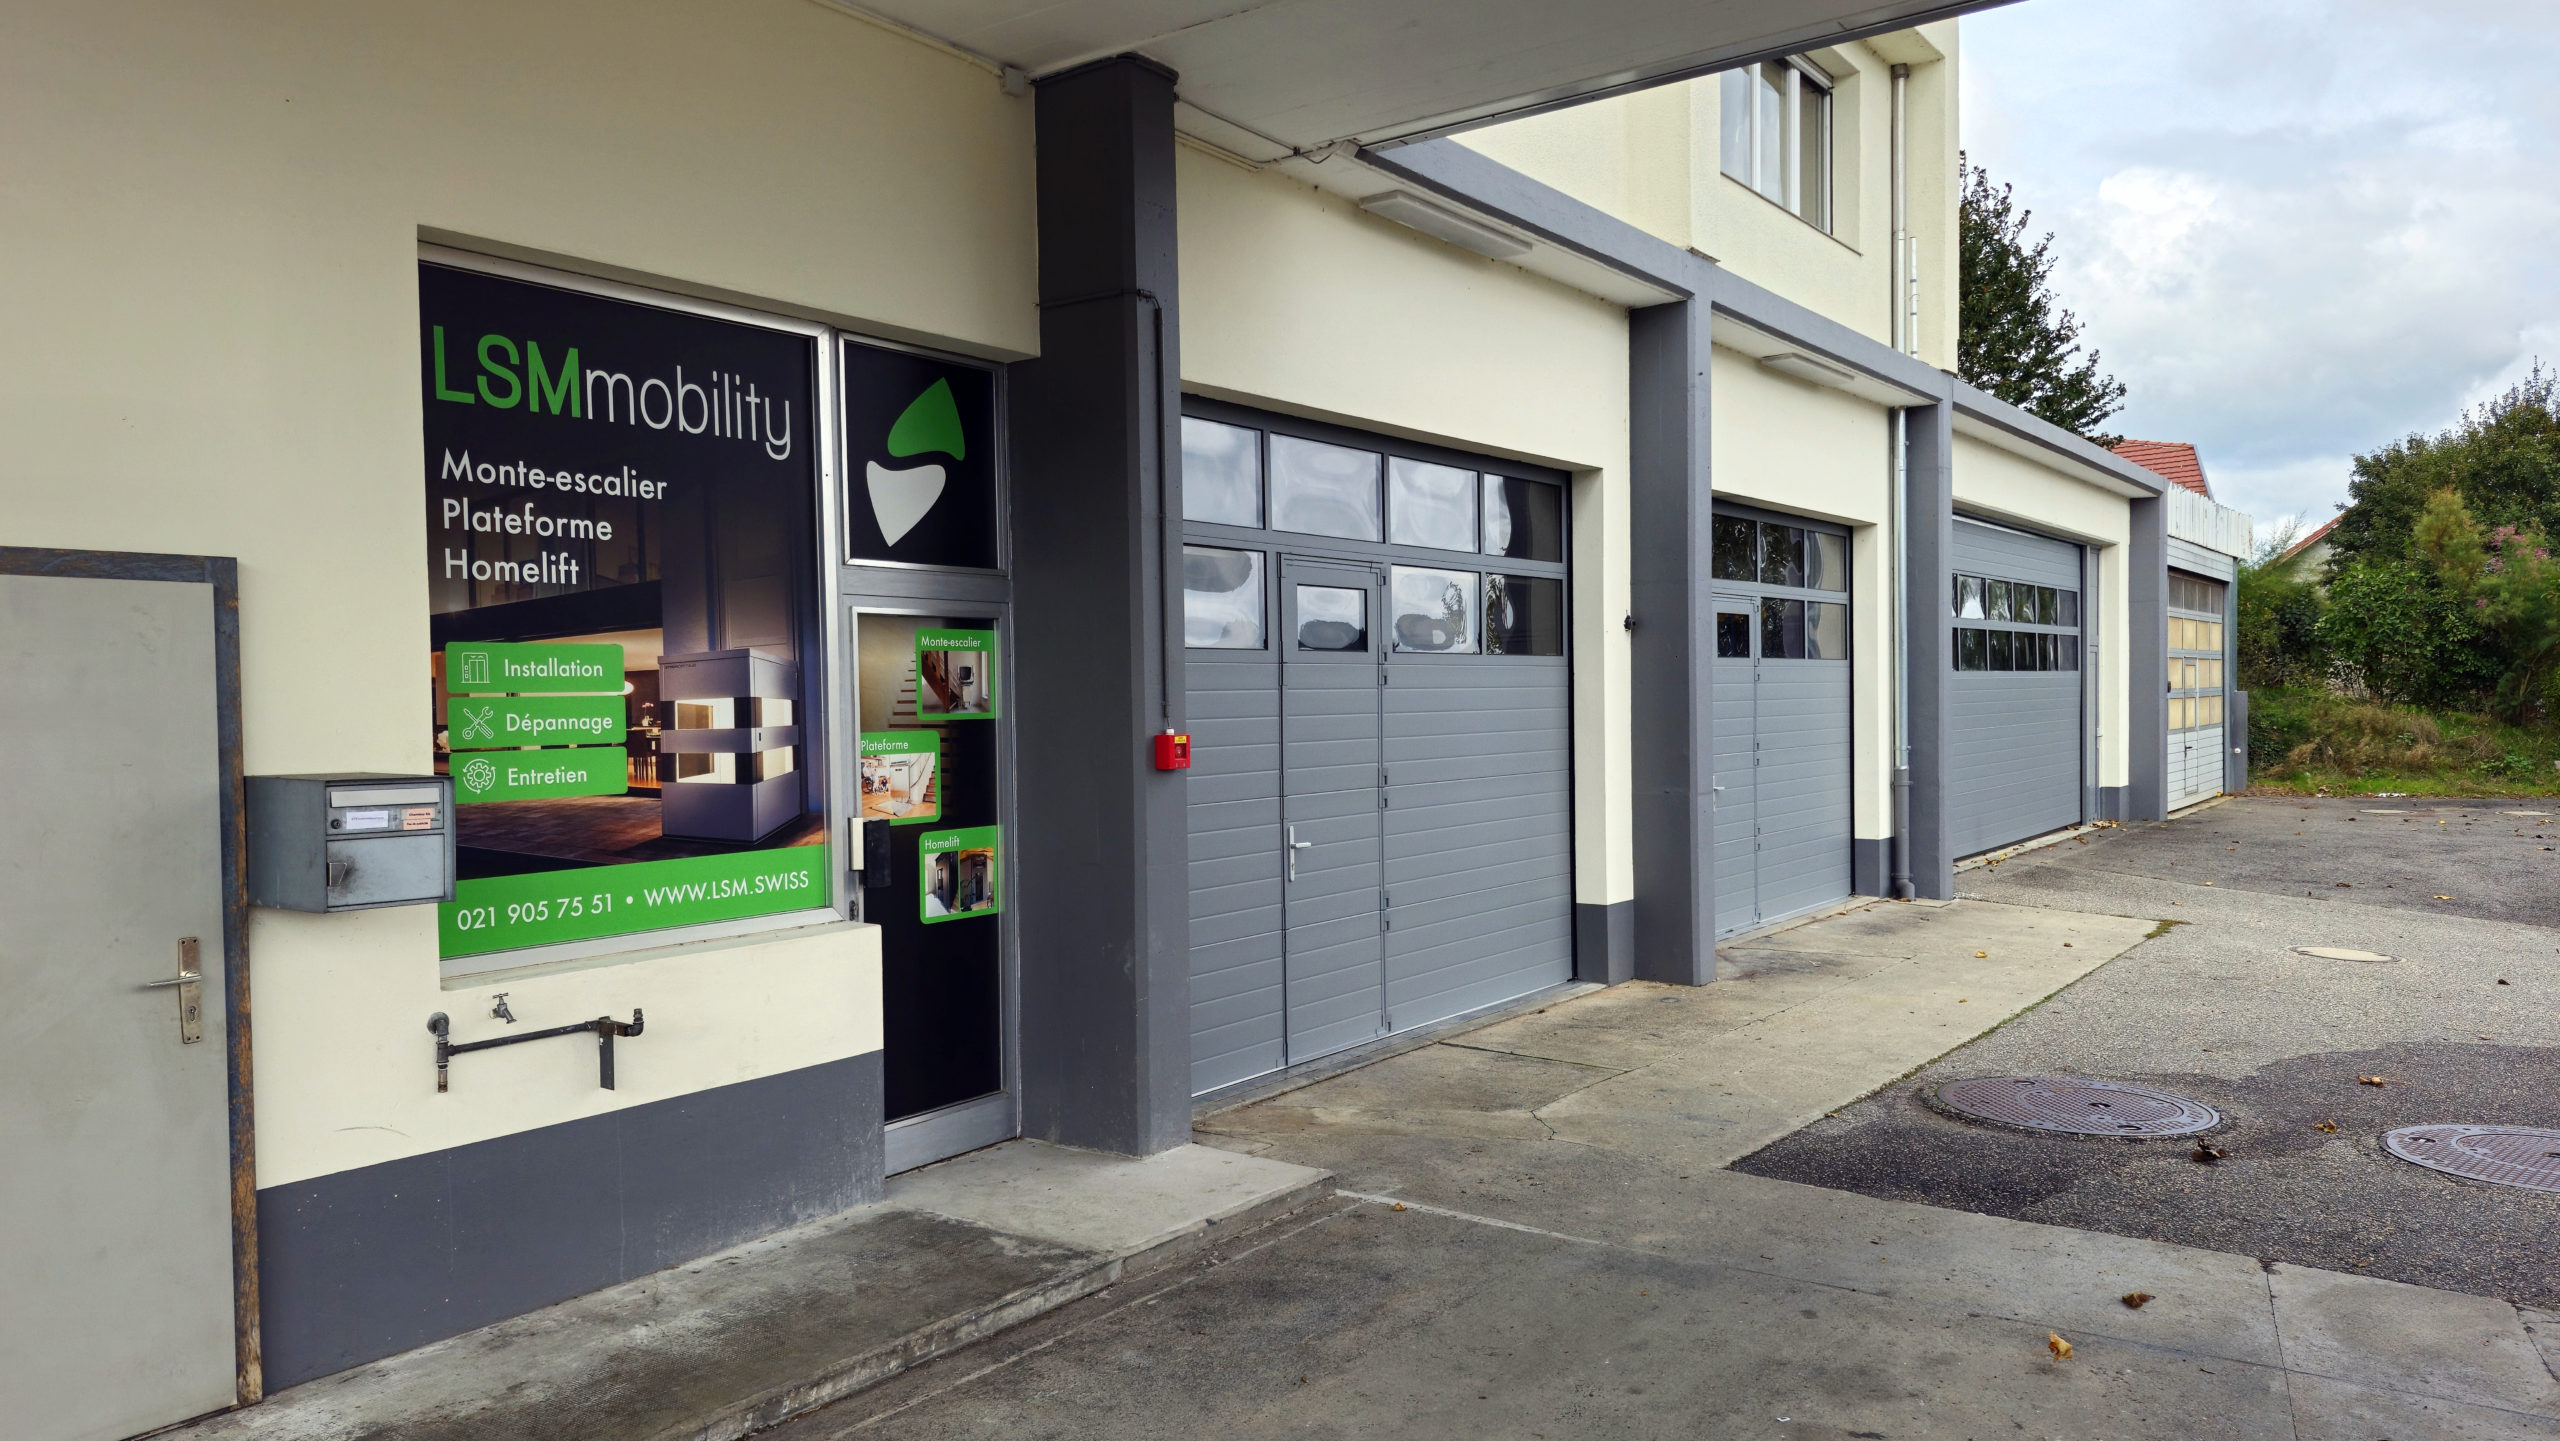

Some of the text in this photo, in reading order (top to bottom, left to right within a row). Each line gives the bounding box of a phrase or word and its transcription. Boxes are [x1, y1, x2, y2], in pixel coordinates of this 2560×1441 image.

[433, 325, 791, 461] LSMmobility
[441, 447, 668, 500] Monte-escalier
[443, 497, 613, 541] Plateforme
[444, 548, 580, 585] Homelift
[921, 635, 981, 648] Monte-escalier
[504, 657, 603, 677] Installation
[506, 713, 613, 737] Dépannage
[861, 739, 909, 751] Plateforme
[508, 766, 588, 786] Entretien
[924, 836, 960, 849] Homelift
[457, 870, 809, 931] 021 905 75 51 WWW.LSM.SWISS
